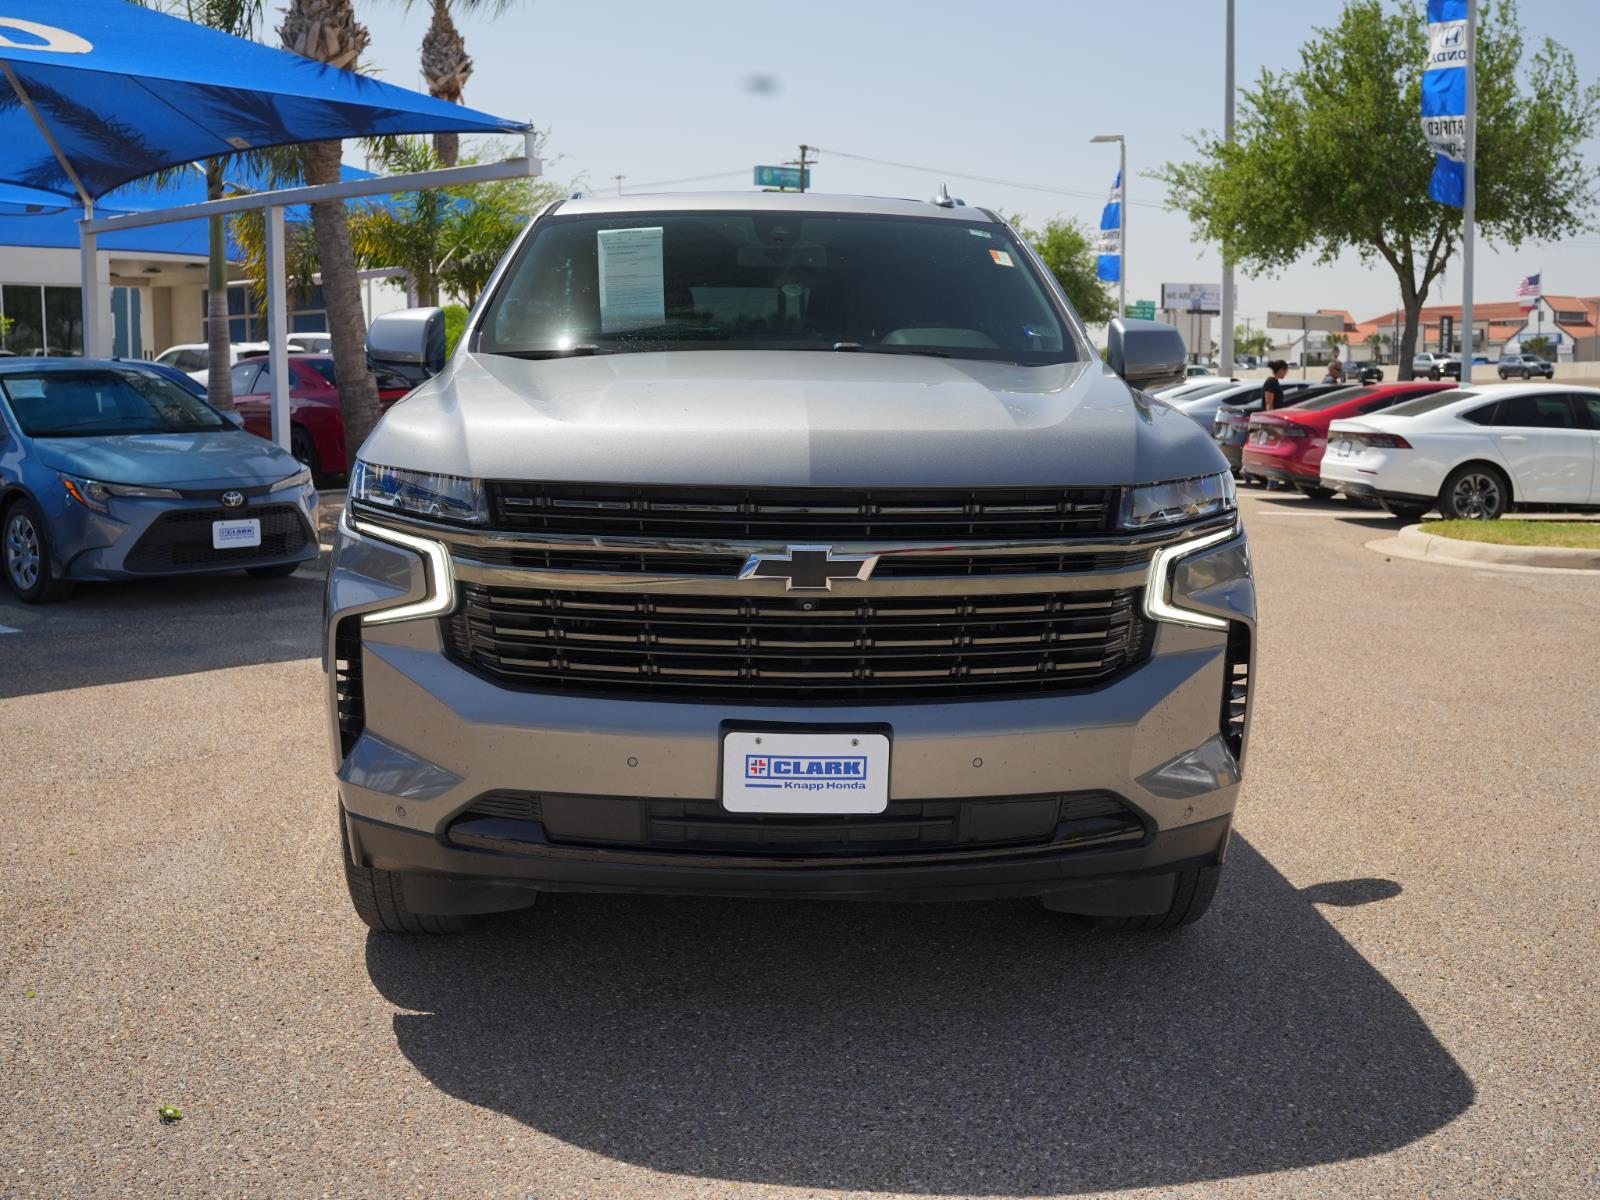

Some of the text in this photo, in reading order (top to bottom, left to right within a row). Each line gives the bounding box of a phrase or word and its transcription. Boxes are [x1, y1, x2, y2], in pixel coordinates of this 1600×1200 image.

[773, 760, 861, 775] CLARK
[784, 781, 866, 791] Knapp Honda
